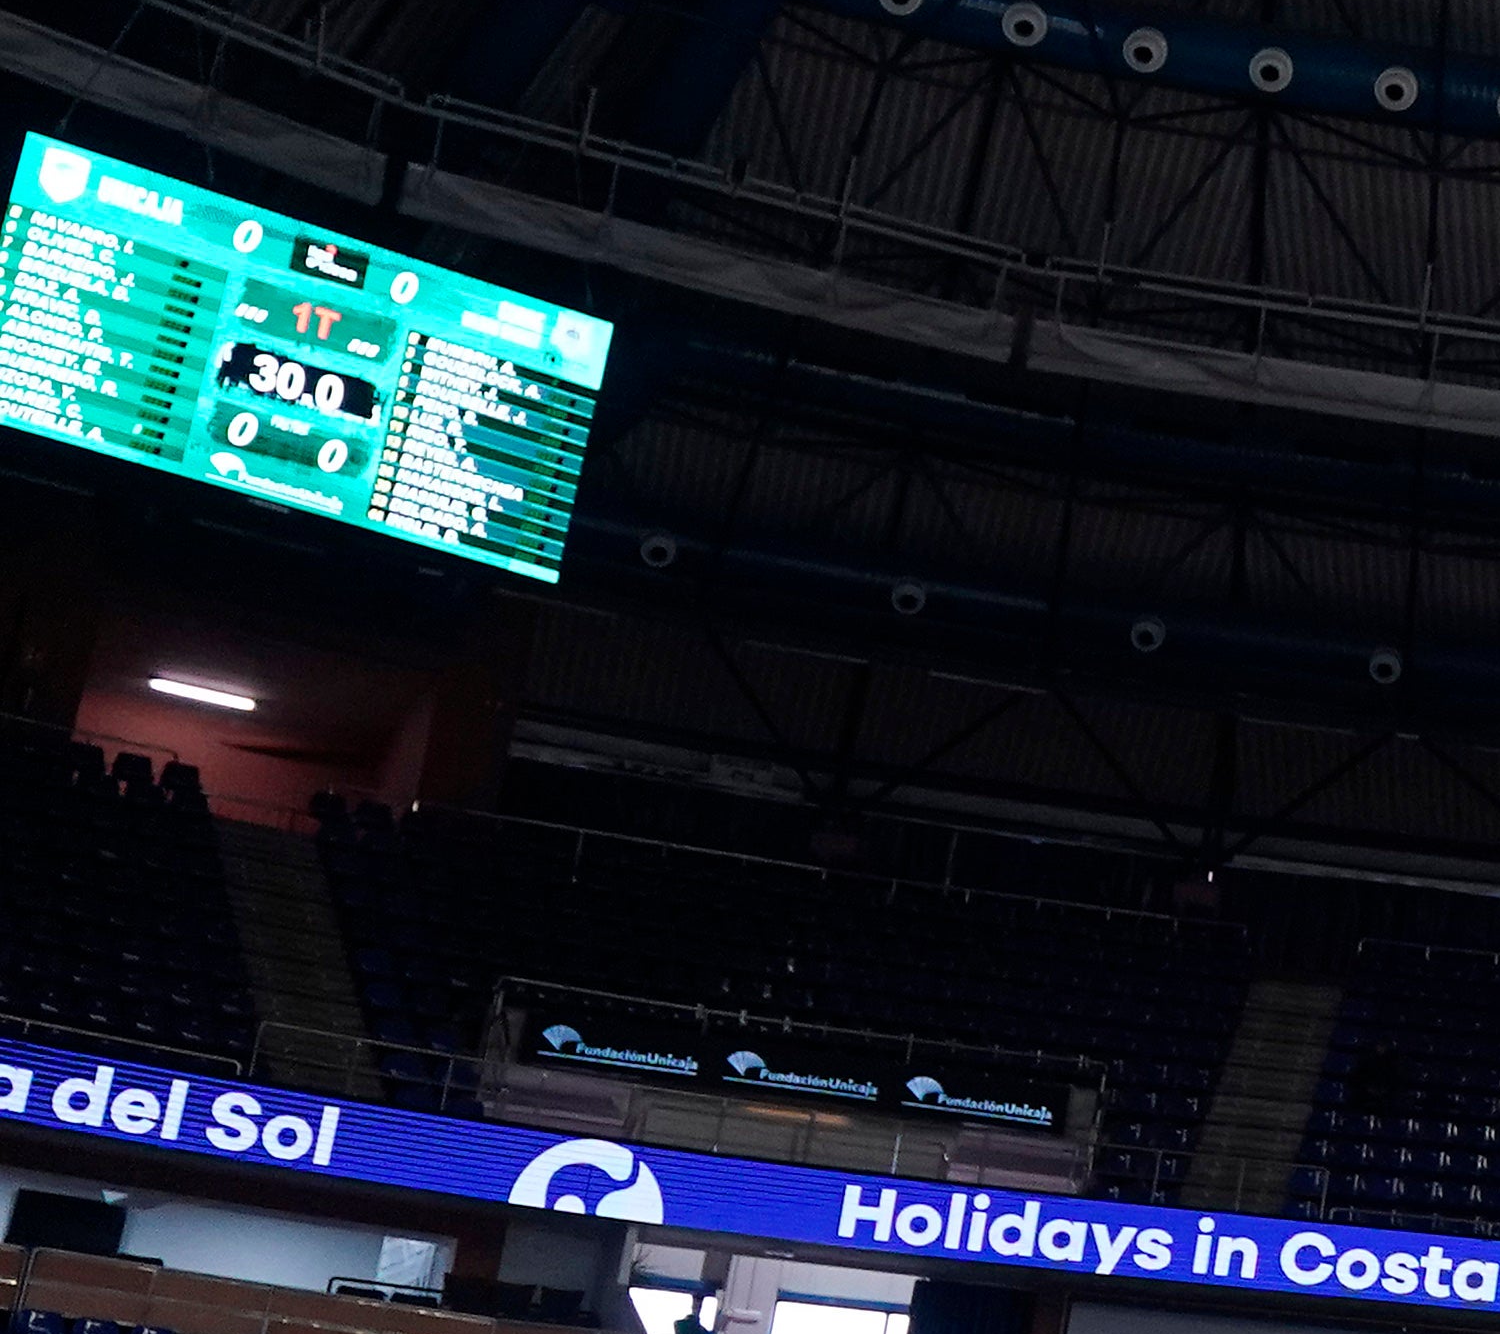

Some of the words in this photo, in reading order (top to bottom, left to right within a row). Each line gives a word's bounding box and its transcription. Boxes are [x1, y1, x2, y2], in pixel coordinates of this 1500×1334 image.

[232, 220, 263, 253] 0
[390, 271, 419, 305] 0
[292, 302, 342, 340] 1T
[249, 354, 345, 412] 30.0
[227, 412, 259, 447] 0
[317, 438, 348, 473] 0
[52, 1065, 189, 1141] del
[206, 1092, 340, 1166] Sol
[839, 1184, 1174, 1278] Holidays
[1193, 1217, 1258, 1284] in
[1280, 1231, 1498, 1307] Costa
